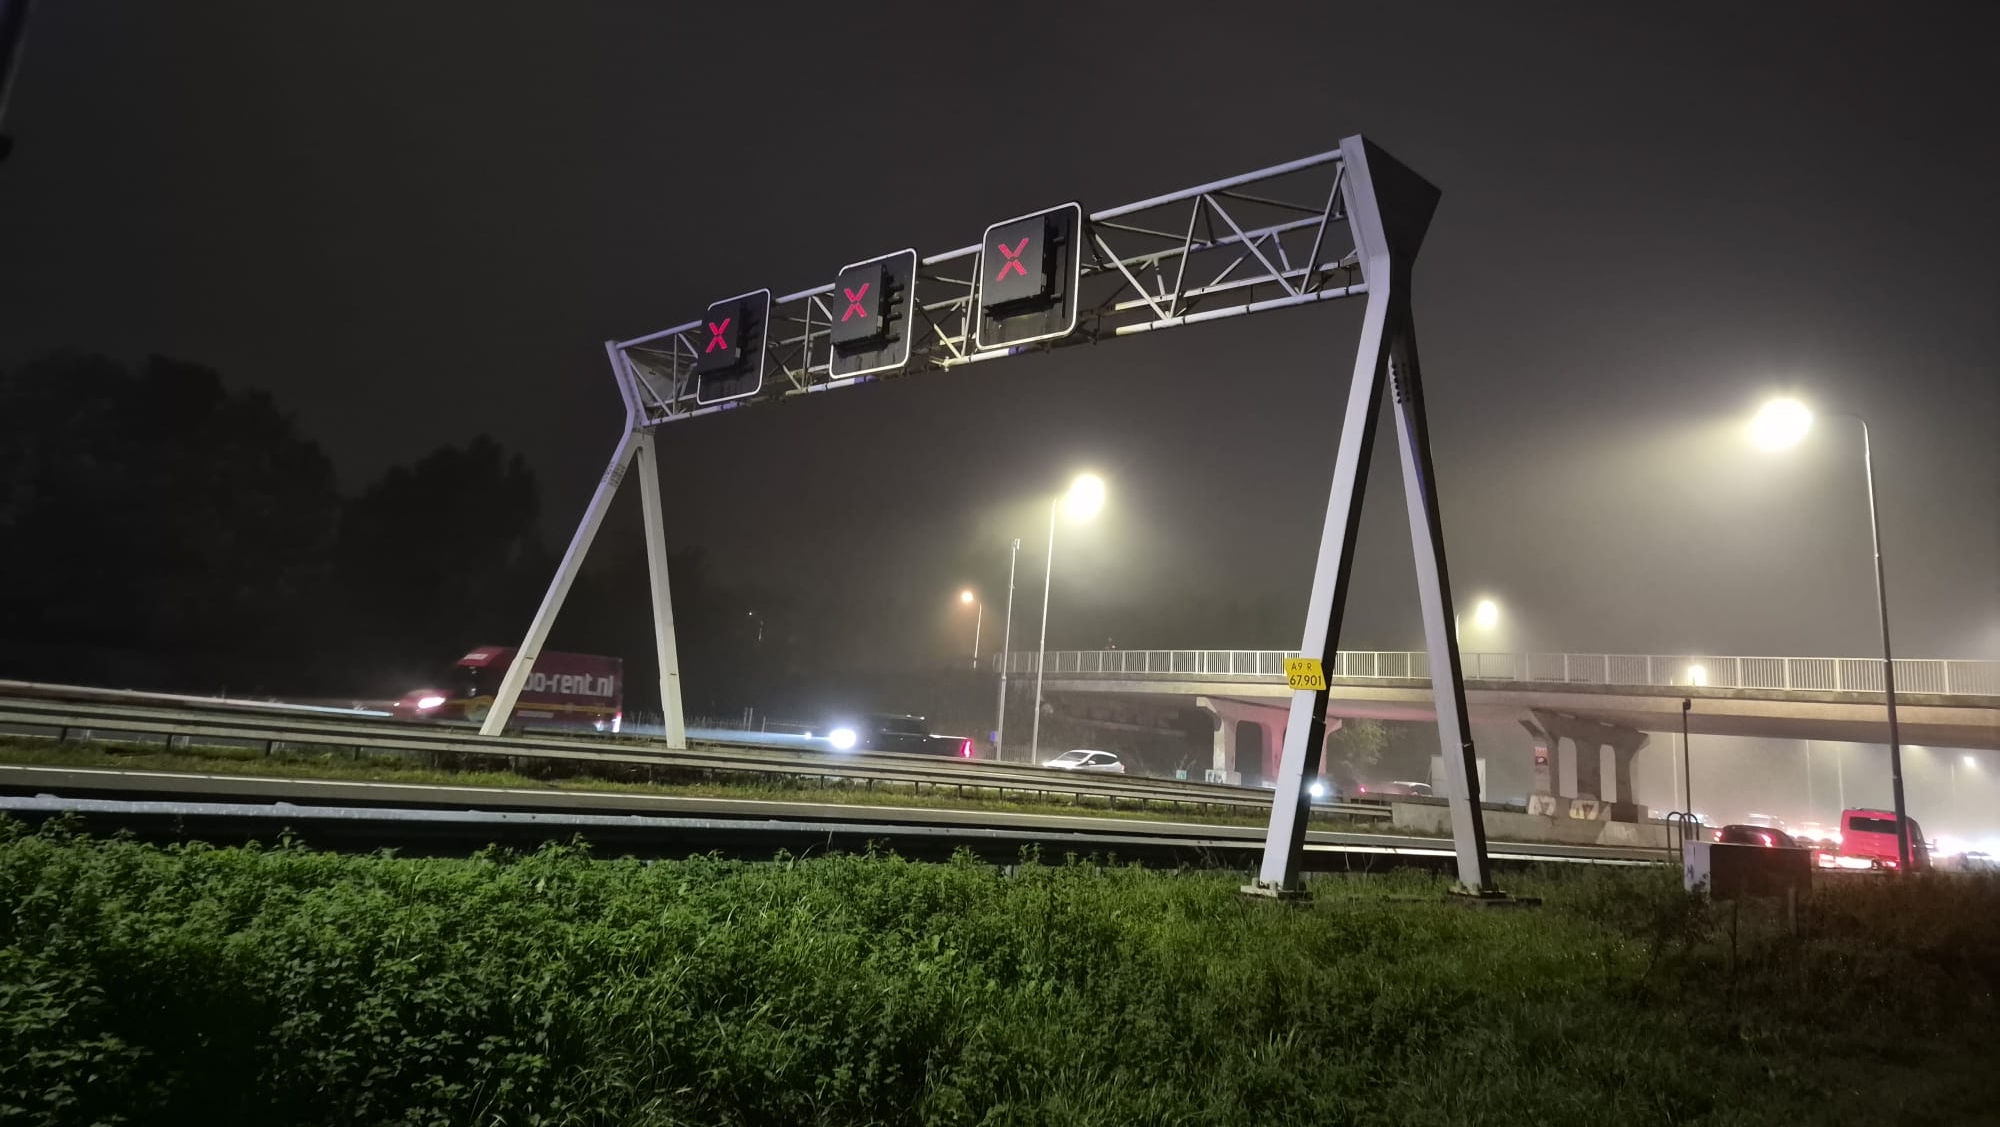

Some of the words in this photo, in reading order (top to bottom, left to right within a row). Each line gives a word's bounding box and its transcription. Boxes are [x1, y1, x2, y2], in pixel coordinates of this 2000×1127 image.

[1291, 662, 1303, 671] A9
[1306, 662, 1313, 672] R
[1289, 674, 1322, 687] 67.901
